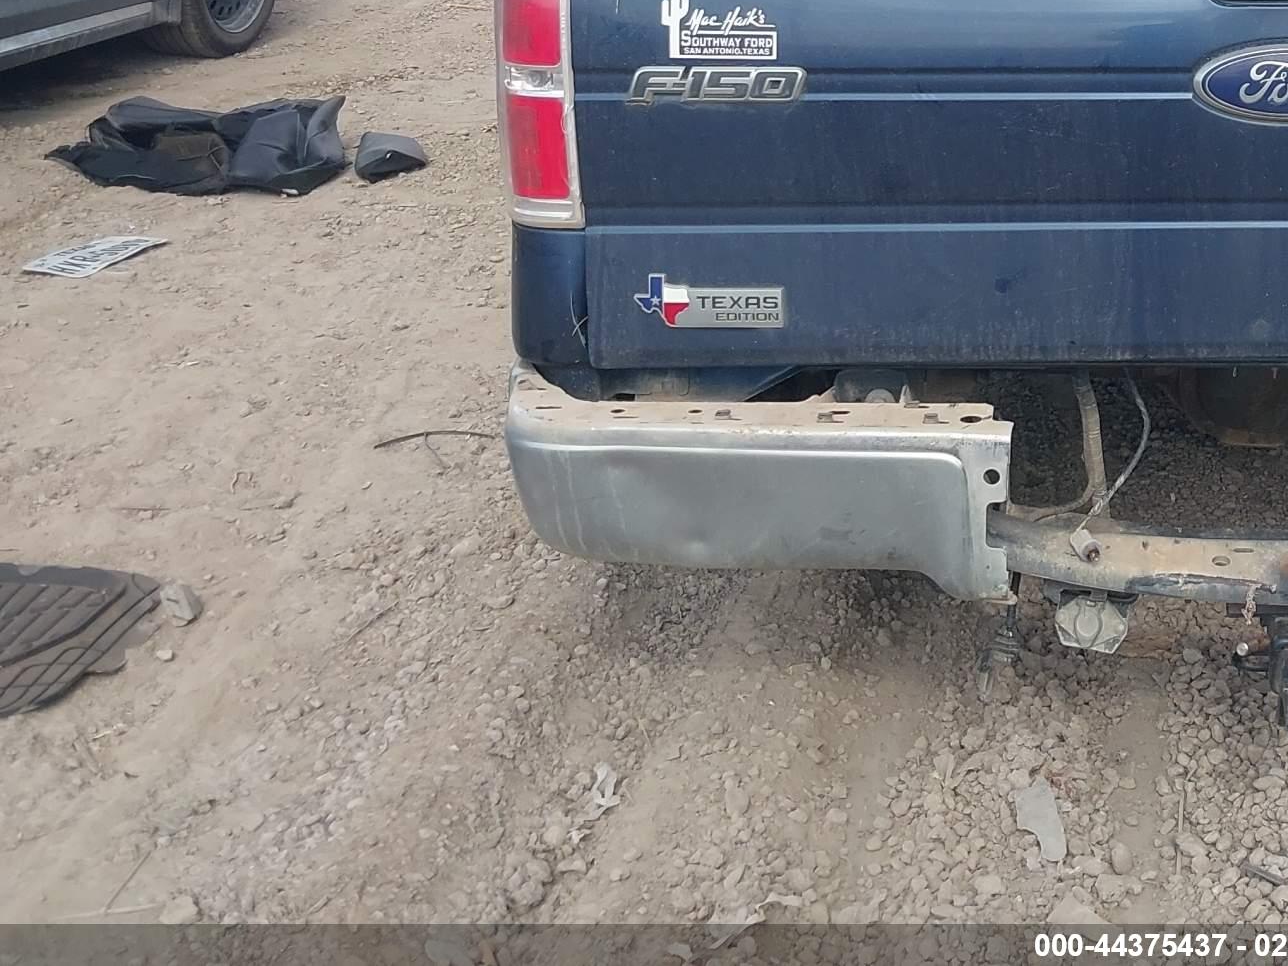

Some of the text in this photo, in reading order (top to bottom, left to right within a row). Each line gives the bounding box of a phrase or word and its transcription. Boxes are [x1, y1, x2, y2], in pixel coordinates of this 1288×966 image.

[685, 9, 722, 34] Mac
[681, 30, 773, 47] SOUTHWAY FORD
[626, 66, 807, 105] F-150
[696, 296, 778, 309] TEXAS
[715, 312, 780, 321] EDITION
